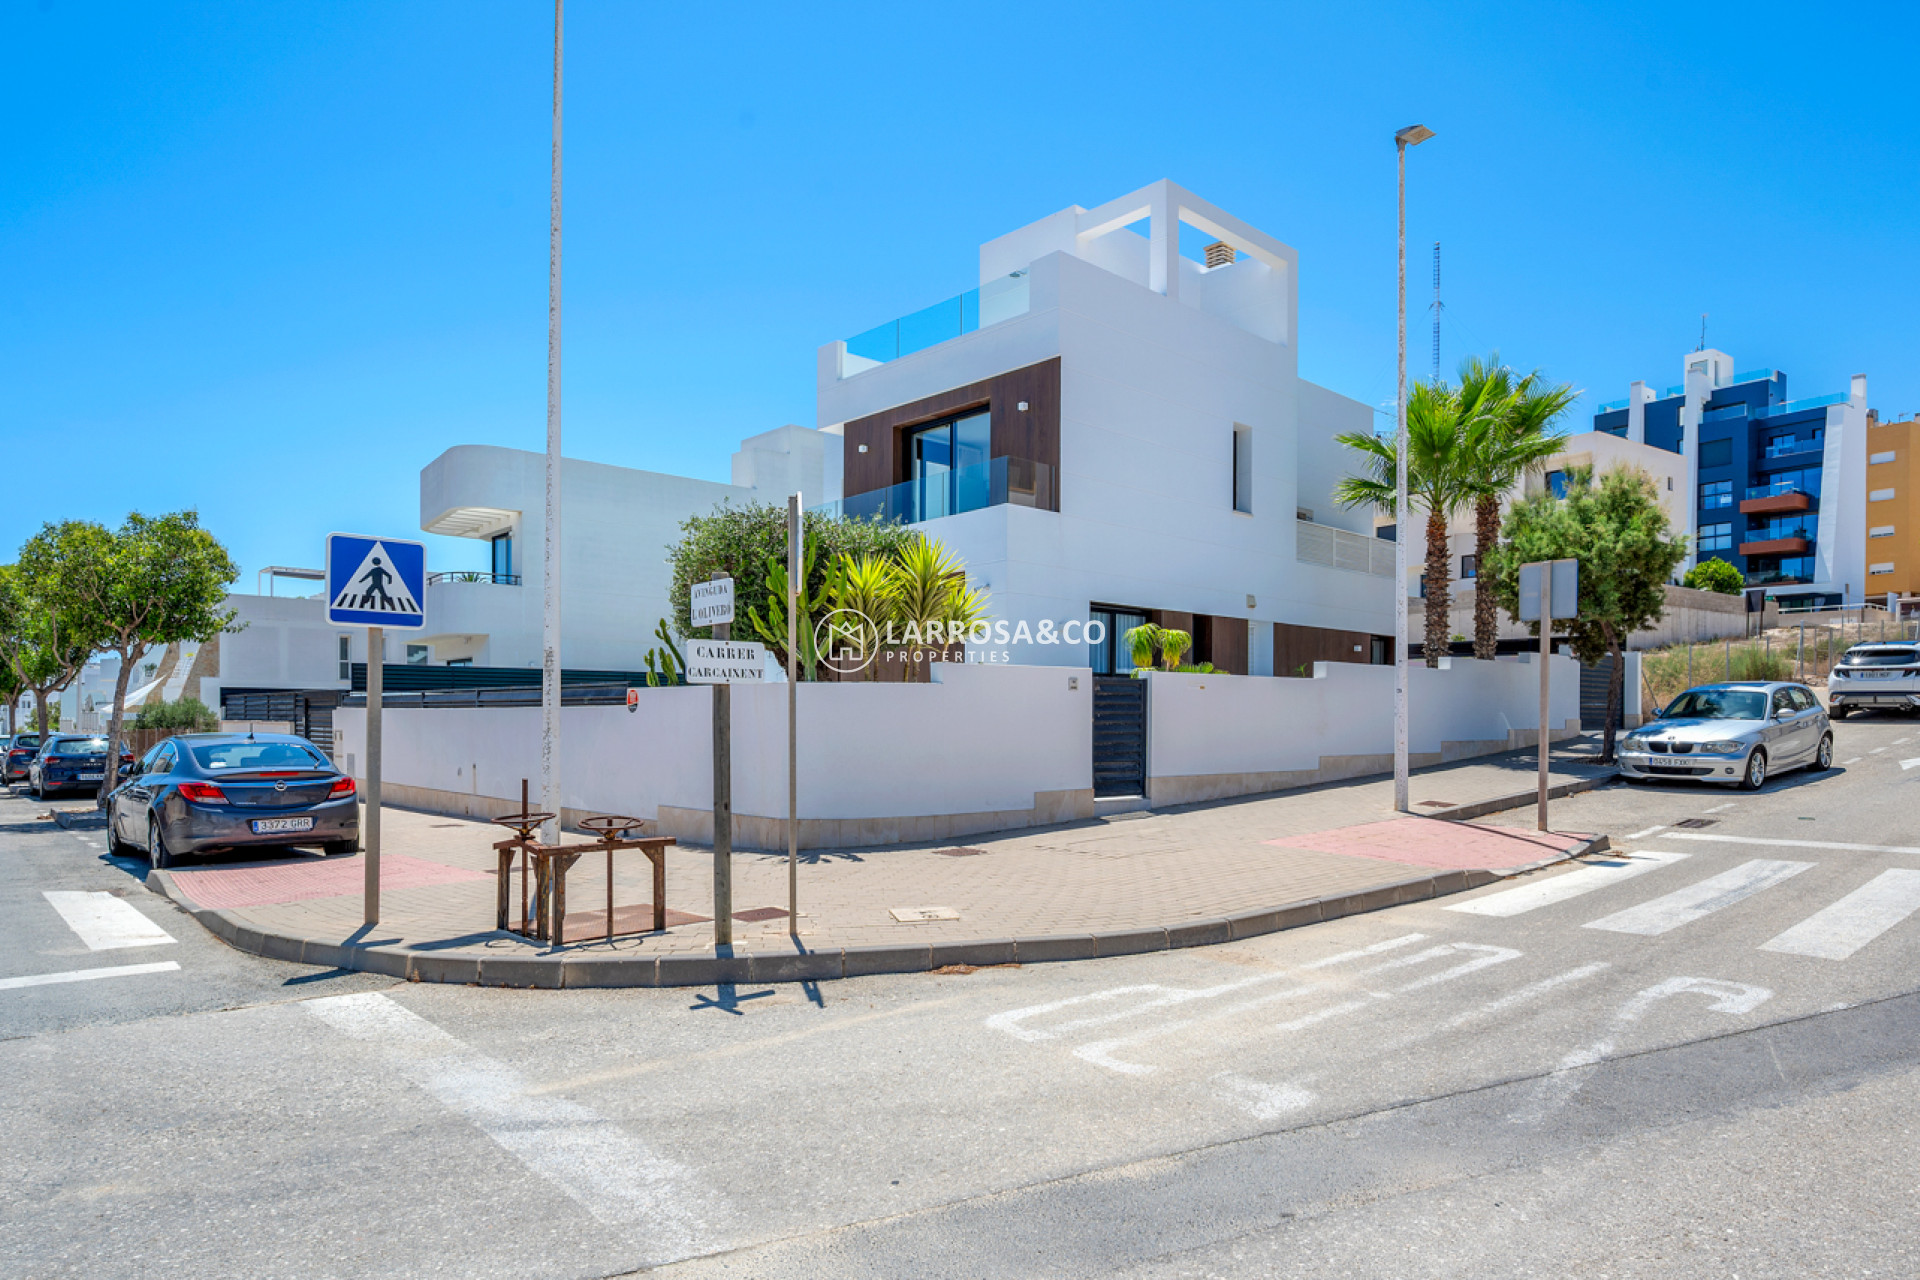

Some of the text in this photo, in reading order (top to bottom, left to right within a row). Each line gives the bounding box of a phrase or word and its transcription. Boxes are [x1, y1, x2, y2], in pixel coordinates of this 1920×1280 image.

[696, 646, 755, 660] CARRER
[687, 667, 764, 679] CARCAIXENT
[261, 820, 288, 830] 3372
